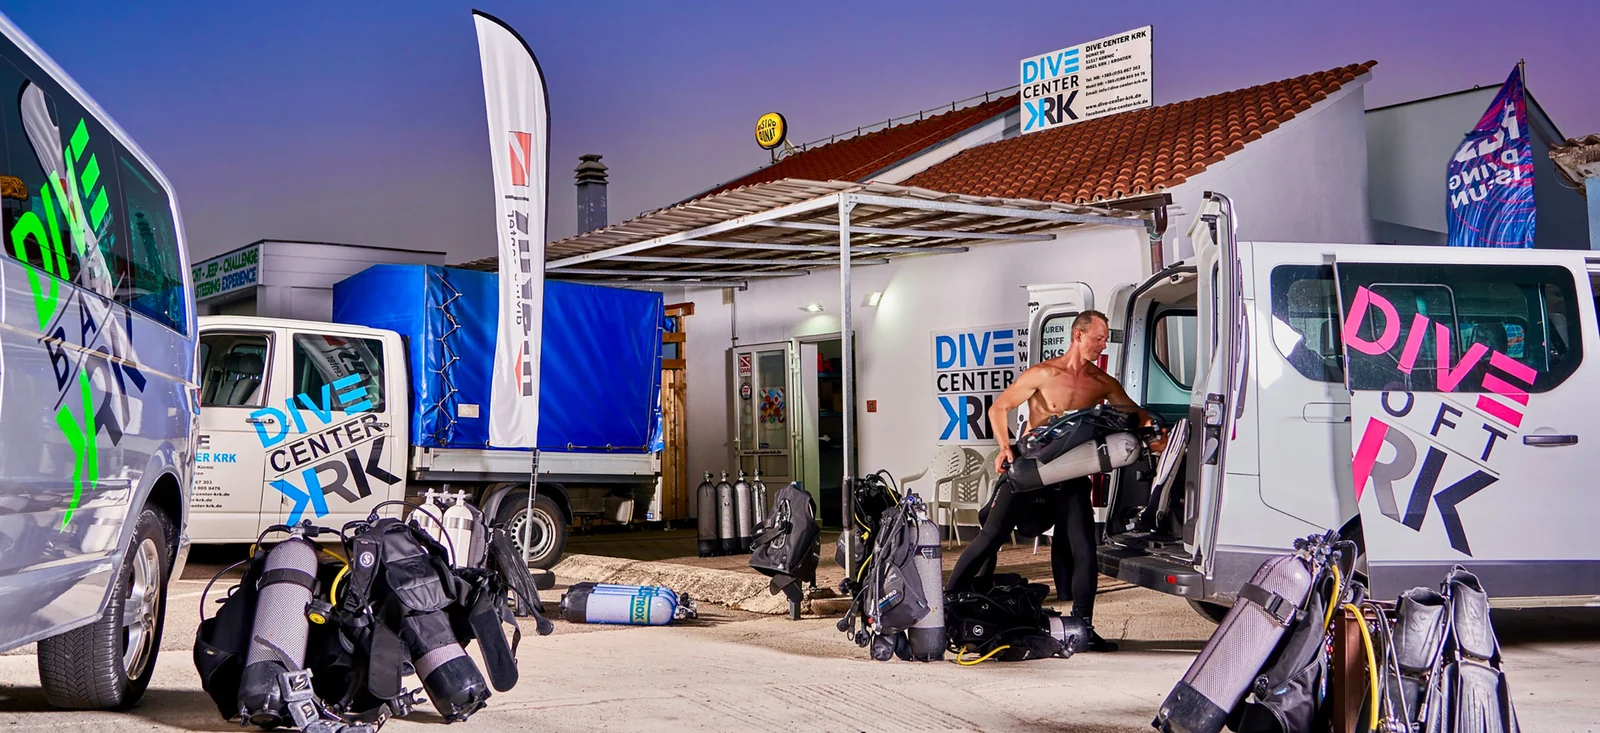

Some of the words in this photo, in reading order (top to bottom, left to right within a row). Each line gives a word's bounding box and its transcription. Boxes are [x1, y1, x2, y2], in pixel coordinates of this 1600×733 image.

[1085, 42, 1102, 53] DIVE
[1103, 35, 1130, 48] CENTER
[1131, 30, 1147, 40] KRK
[1023, 48, 1079, 84] DIVE
[1023, 75, 1079, 99] CENTER
[1023, 90, 1079, 131] KRK
[11, 117, 110, 332] DIVE
[205, 261, 219, 279] JEEP
[223, 248, 259, 273] CHALLENGE
[221, 267, 257, 291] EXPERIENCE
[936, 329, 1015, 369] DIVE
[1341, 285, 1538, 428] DIVE
[937, 369, 1015, 392] CENTER
[249, 372, 373, 449] DIVE
[213, 453, 237, 463] KRK
[270, 413, 384, 472] CENTER
[269, 435, 403, 528] KRK
